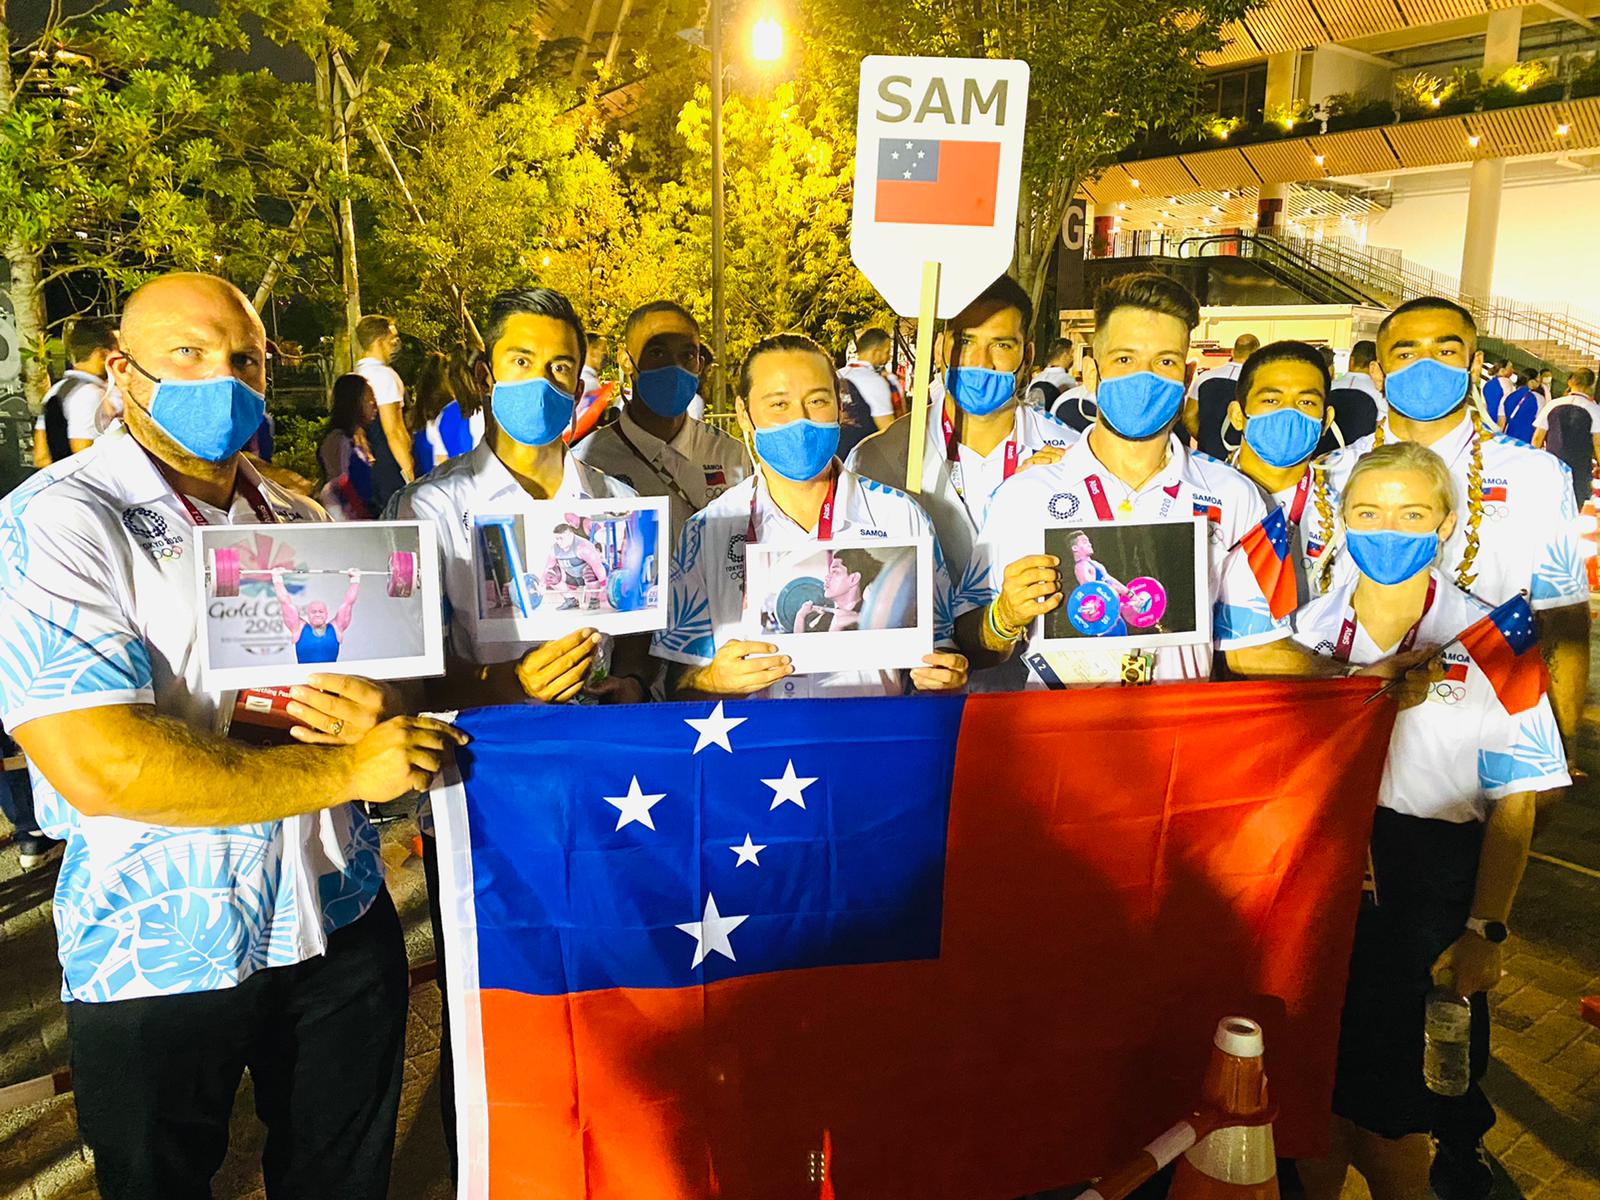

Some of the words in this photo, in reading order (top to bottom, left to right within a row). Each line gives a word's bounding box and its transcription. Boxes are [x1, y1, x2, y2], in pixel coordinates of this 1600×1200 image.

[876, 75, 1008, 126] SAM
[1062, 205, 1084, 250] G
[1160, 498, 1171, 517] 2020
[1192, 493, 1222, 505] SAMOA
[860, 528, 888, 538] SAMOA
[208, 601, 259, 619] Gold
